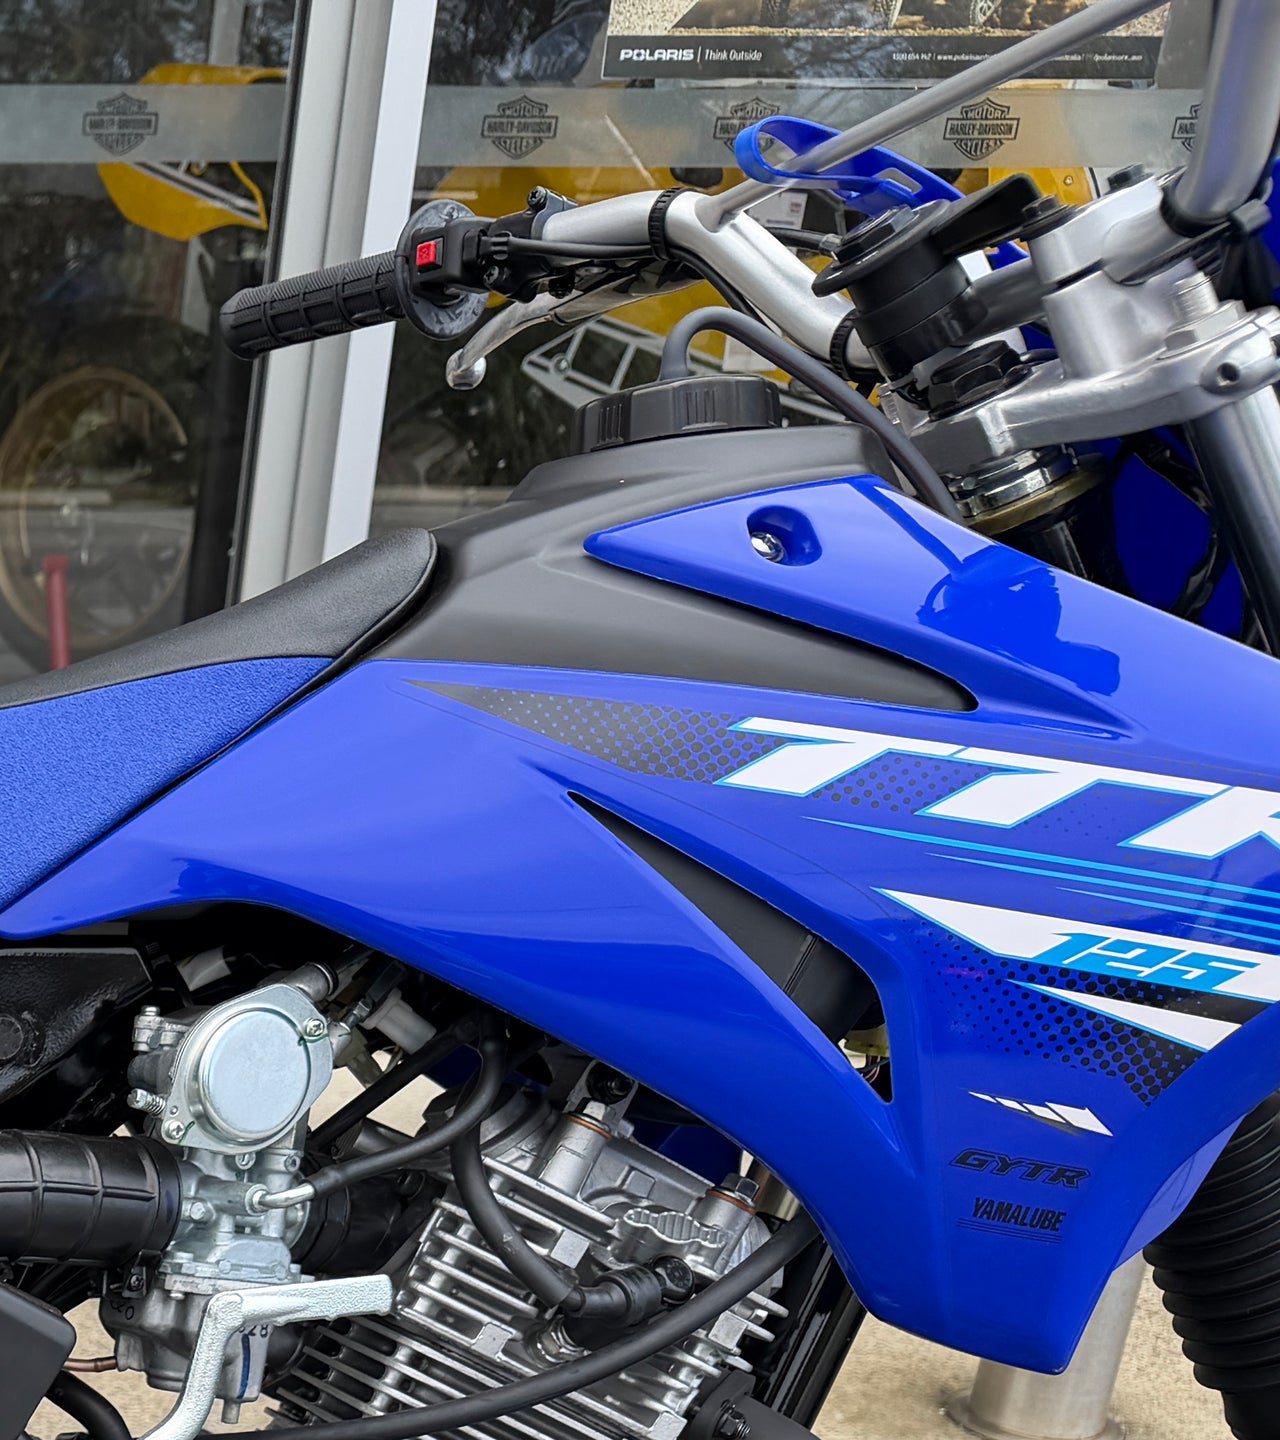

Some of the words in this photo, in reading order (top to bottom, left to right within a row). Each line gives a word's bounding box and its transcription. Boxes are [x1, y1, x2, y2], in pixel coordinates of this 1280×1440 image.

[619, 48, 694, 61] POLARIS
[705, 49, 728, 61] Think
[729, 49, 763, 61] Outside
[965, 104, 1007, 119] MOTOR
[948, 122, 1014, 136] HARLEY-DAVIDSON
[958, 139, 999, 156] CYCLES
[1032, 932, 1261, 994] 125
[947, 1147, 1091, 1189] GYTR
[971, 1197, 1067, 1232] YAMALUBE
